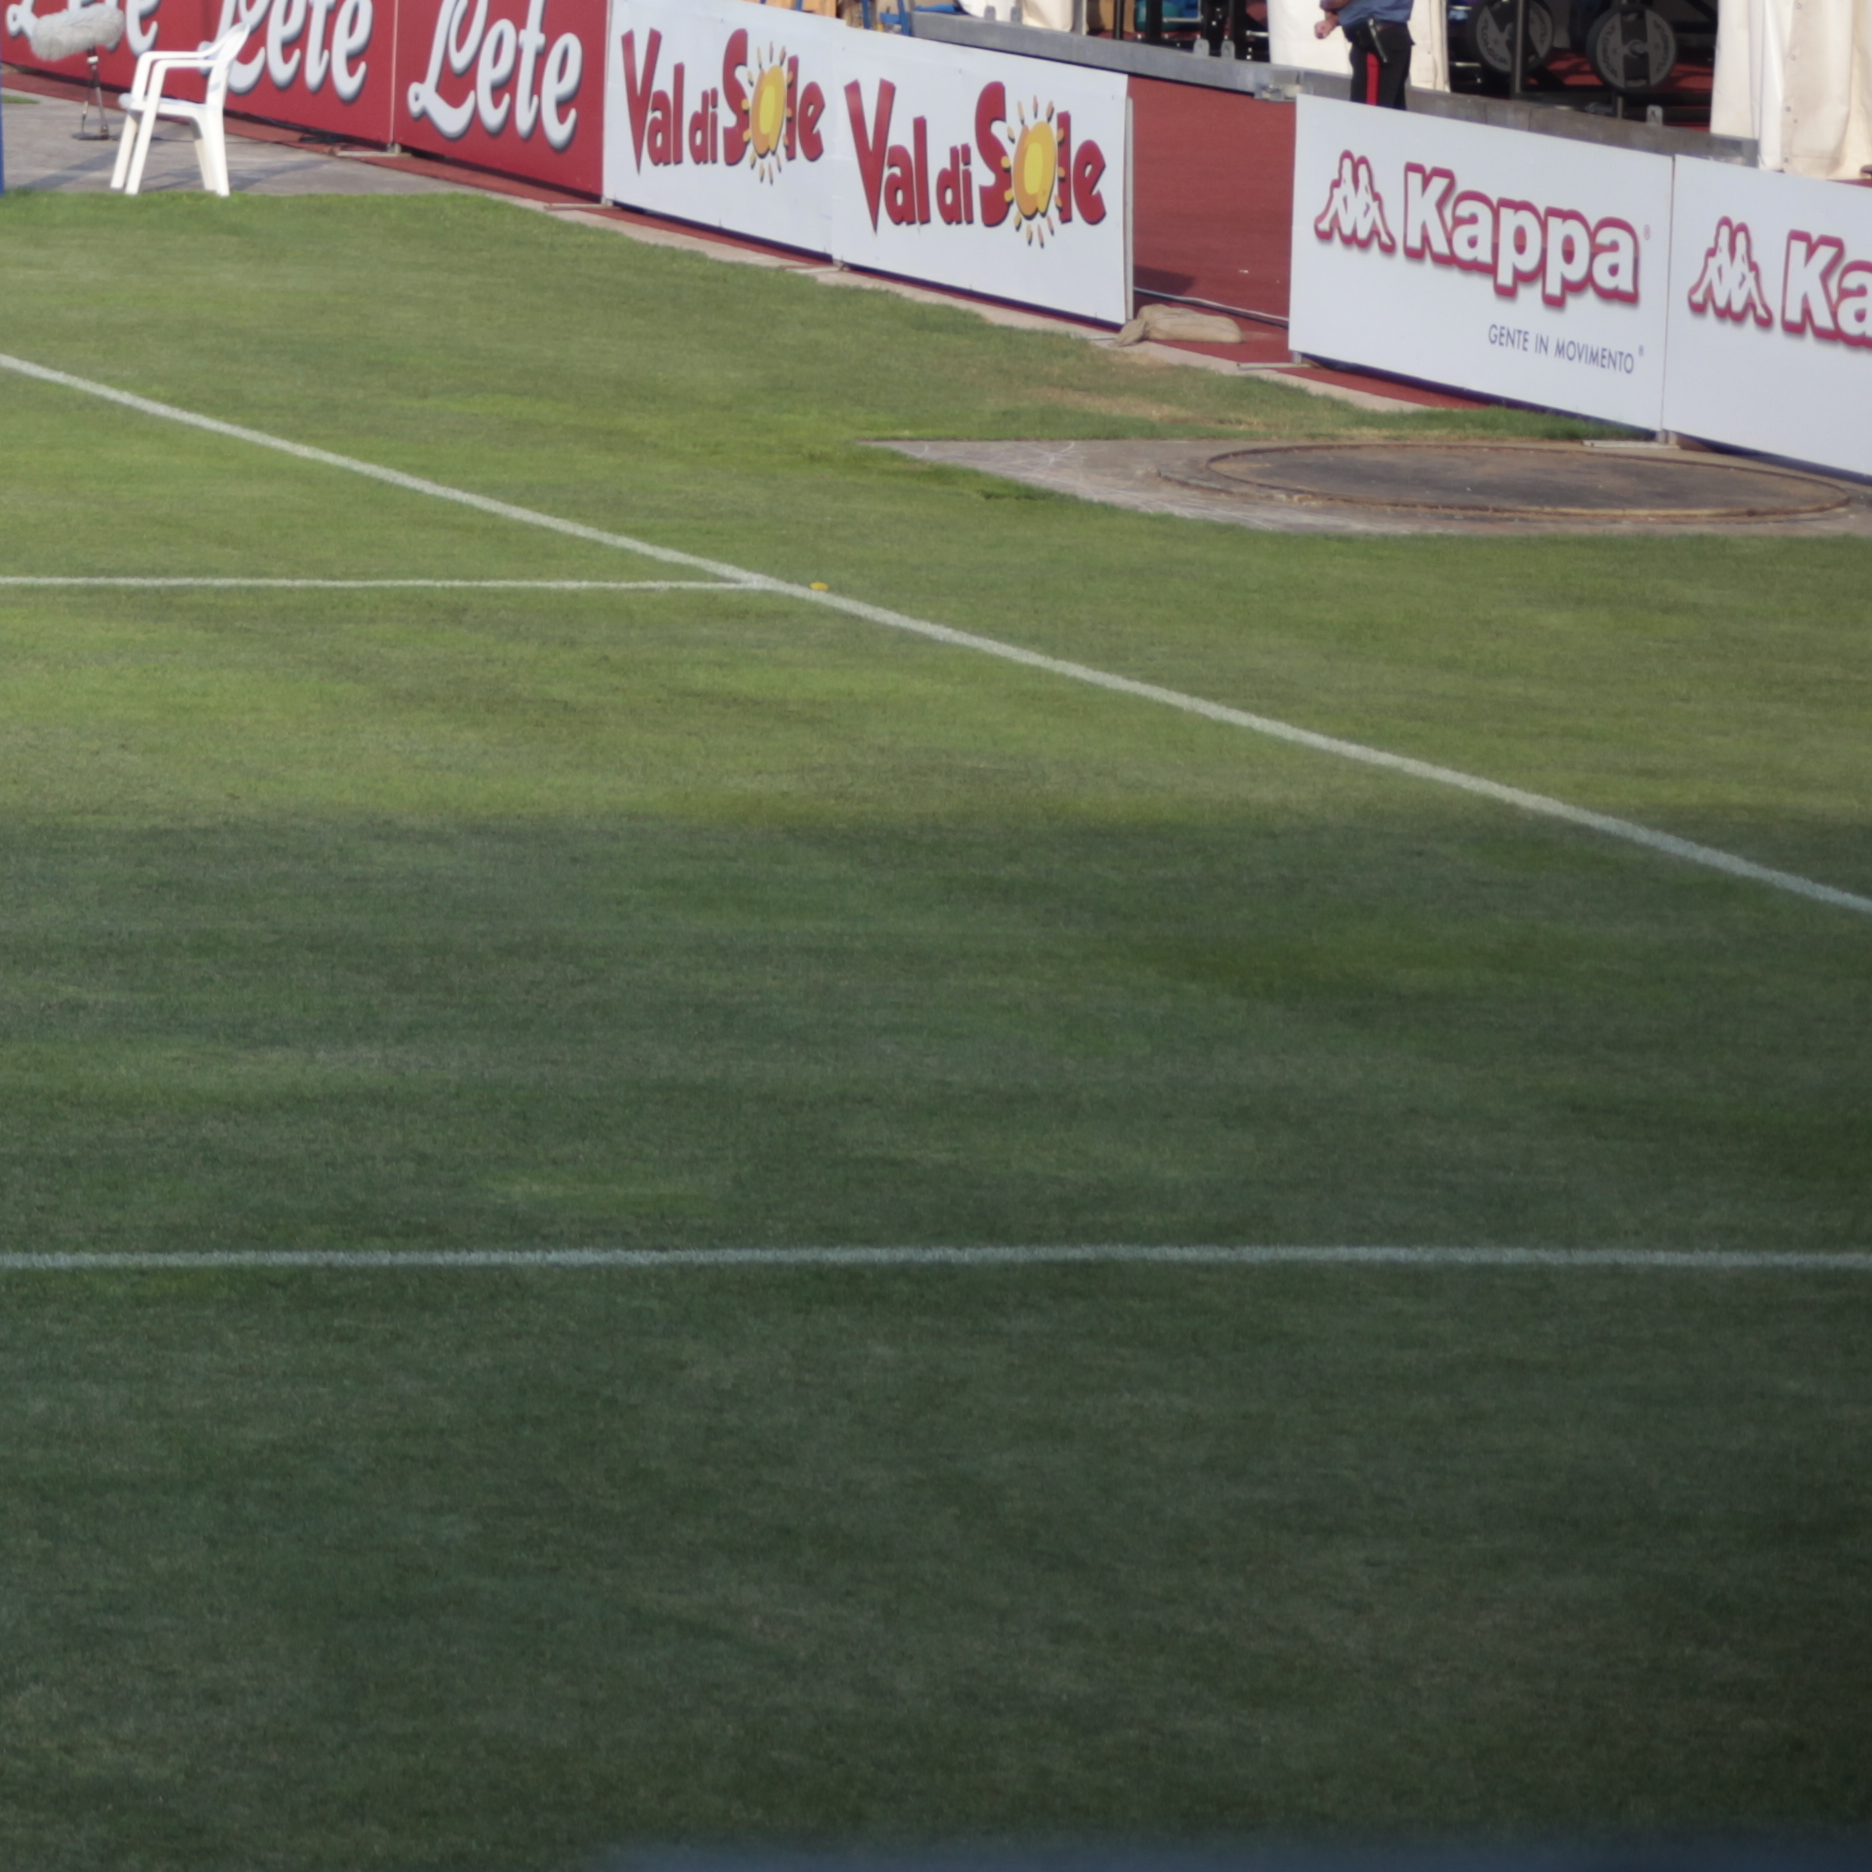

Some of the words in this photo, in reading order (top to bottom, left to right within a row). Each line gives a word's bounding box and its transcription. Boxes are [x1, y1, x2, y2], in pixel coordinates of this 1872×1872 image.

[621, 27, 685, 175] Val
[689, 87, 718, 165] di
[844, 78, 931, 235] Val
[936, 142, 974, 226] di
[1403, 161, 1640, 308] Kappa
[1488, 324, 1530, 353] GENTE
[1534, 337, 1549, 357] IN
[1554, 340, 1635, 376] MOVIMENTO
